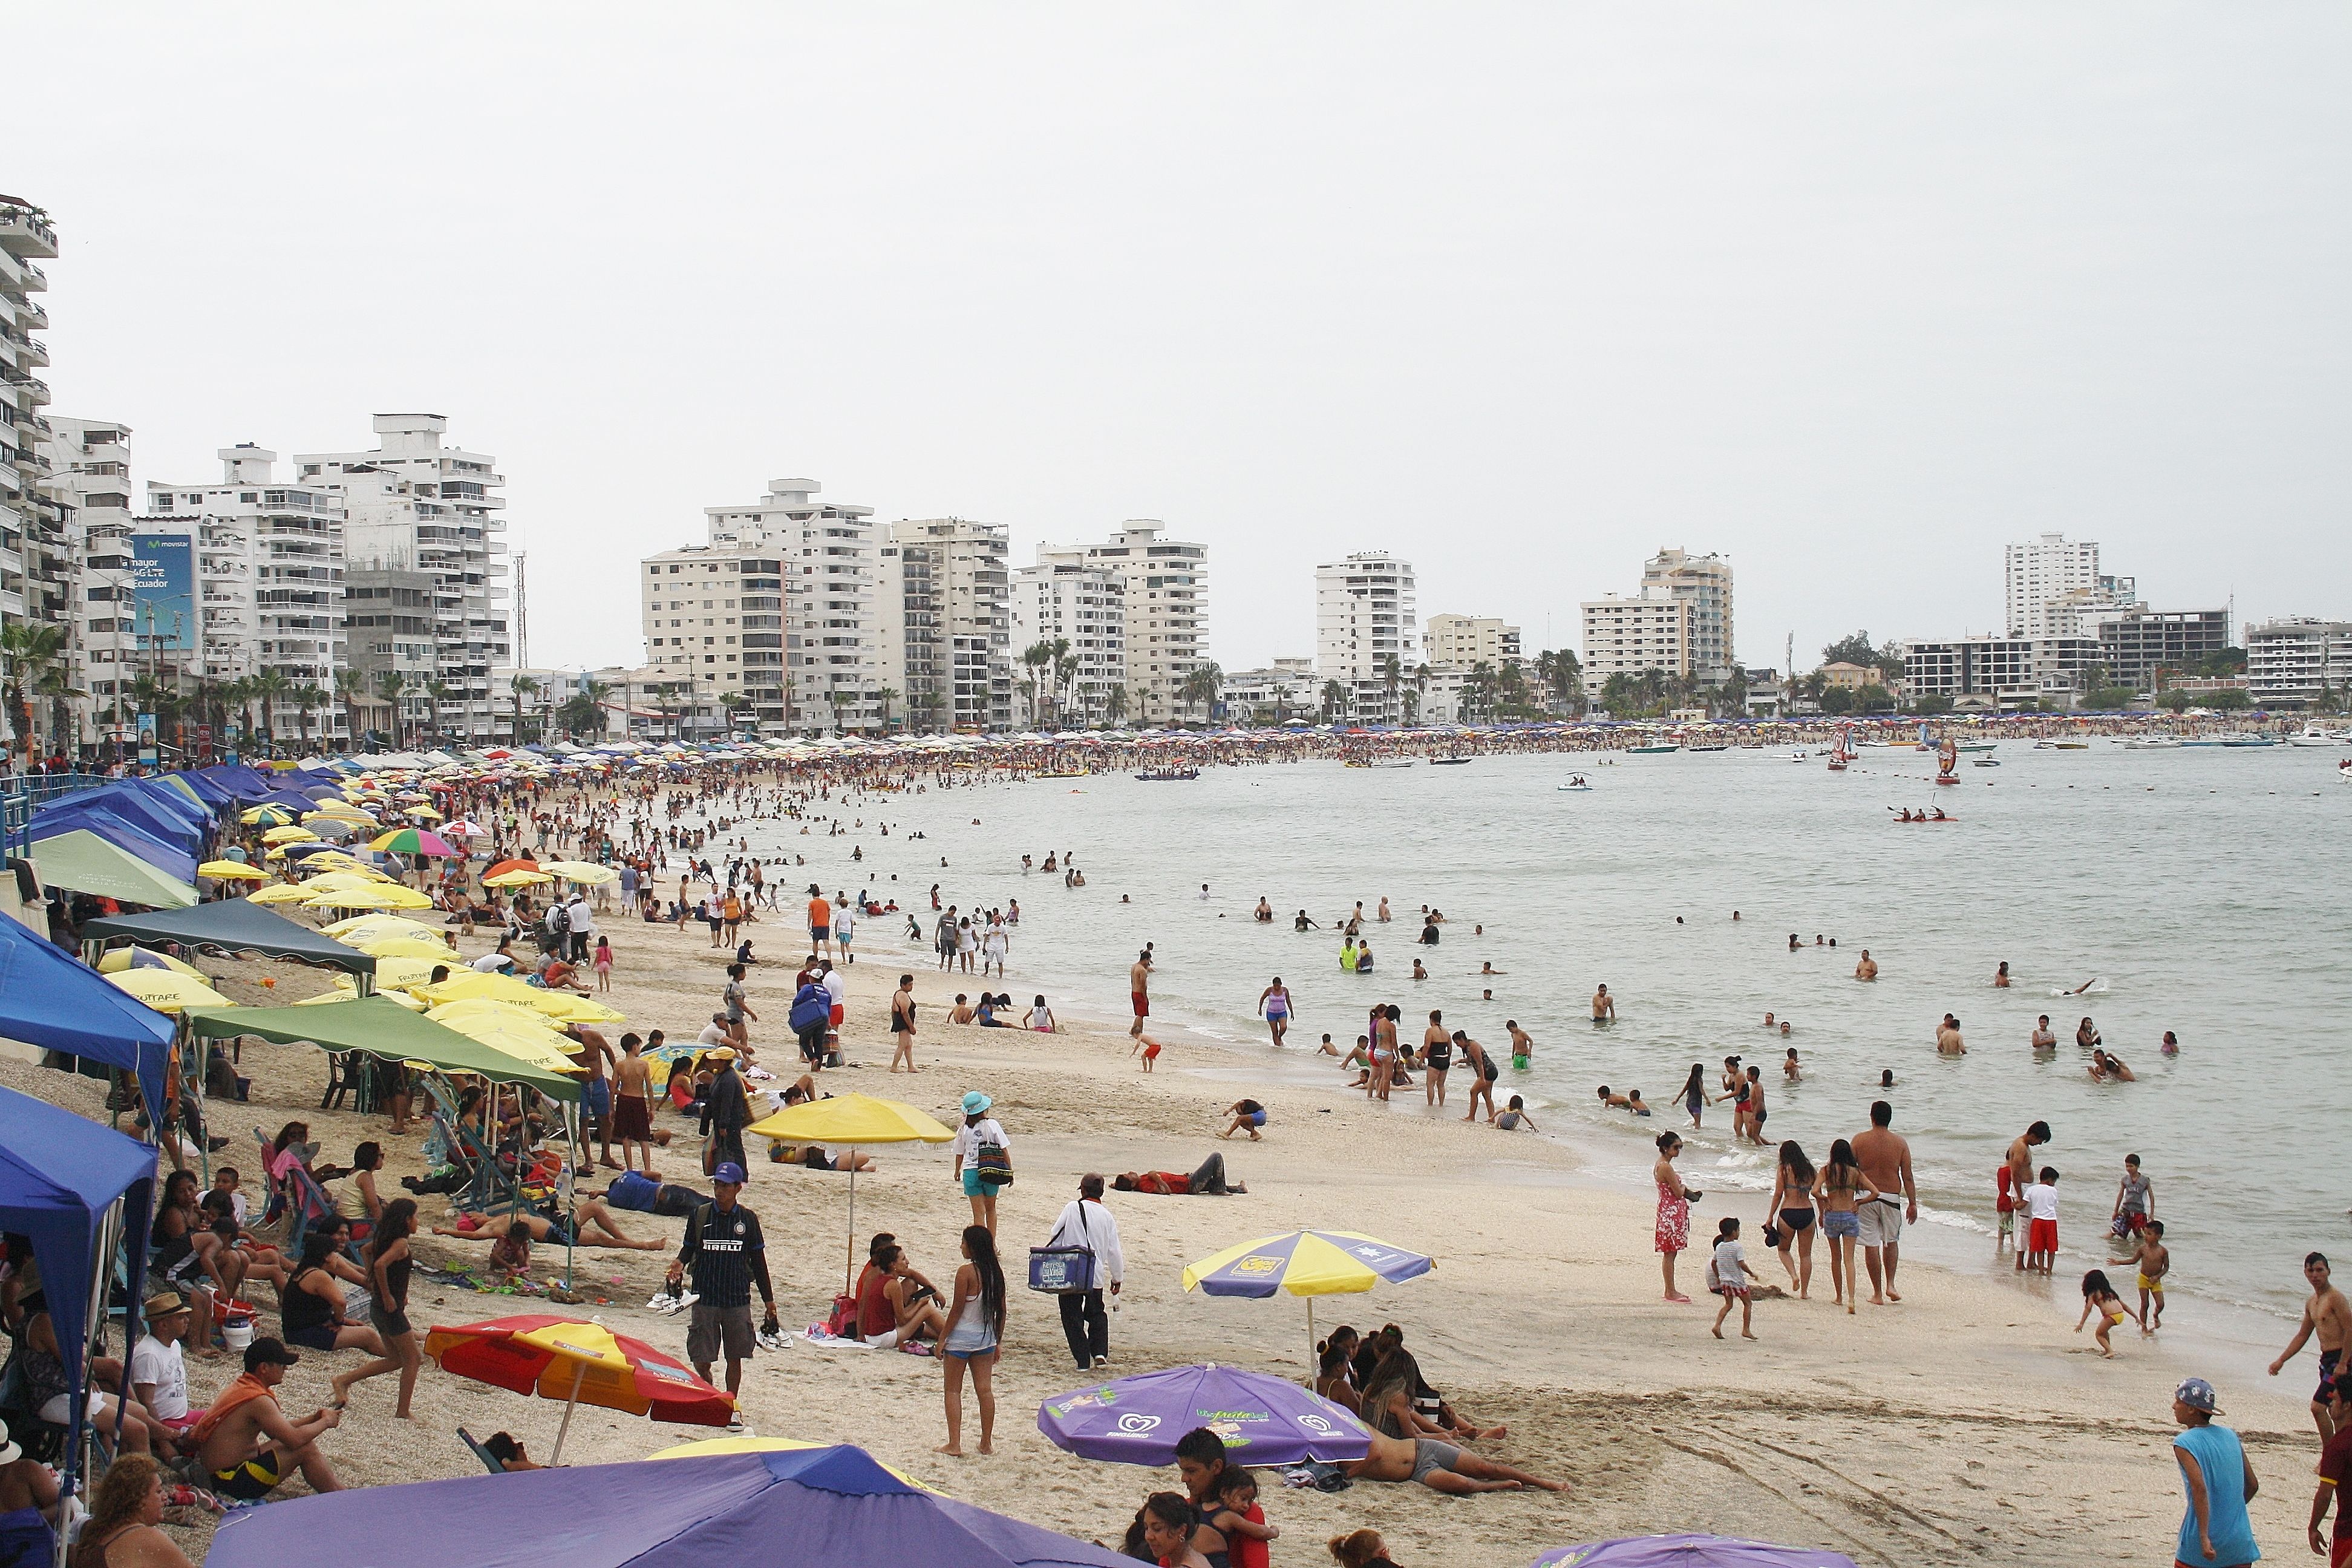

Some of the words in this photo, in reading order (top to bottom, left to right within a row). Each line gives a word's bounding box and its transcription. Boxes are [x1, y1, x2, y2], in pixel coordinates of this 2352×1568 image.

[134, 579, 168, 587] Ecuador
[131, 993, 180, 1002] RUTTARE
[703, 1239, 743, 1252] PIRELLI
